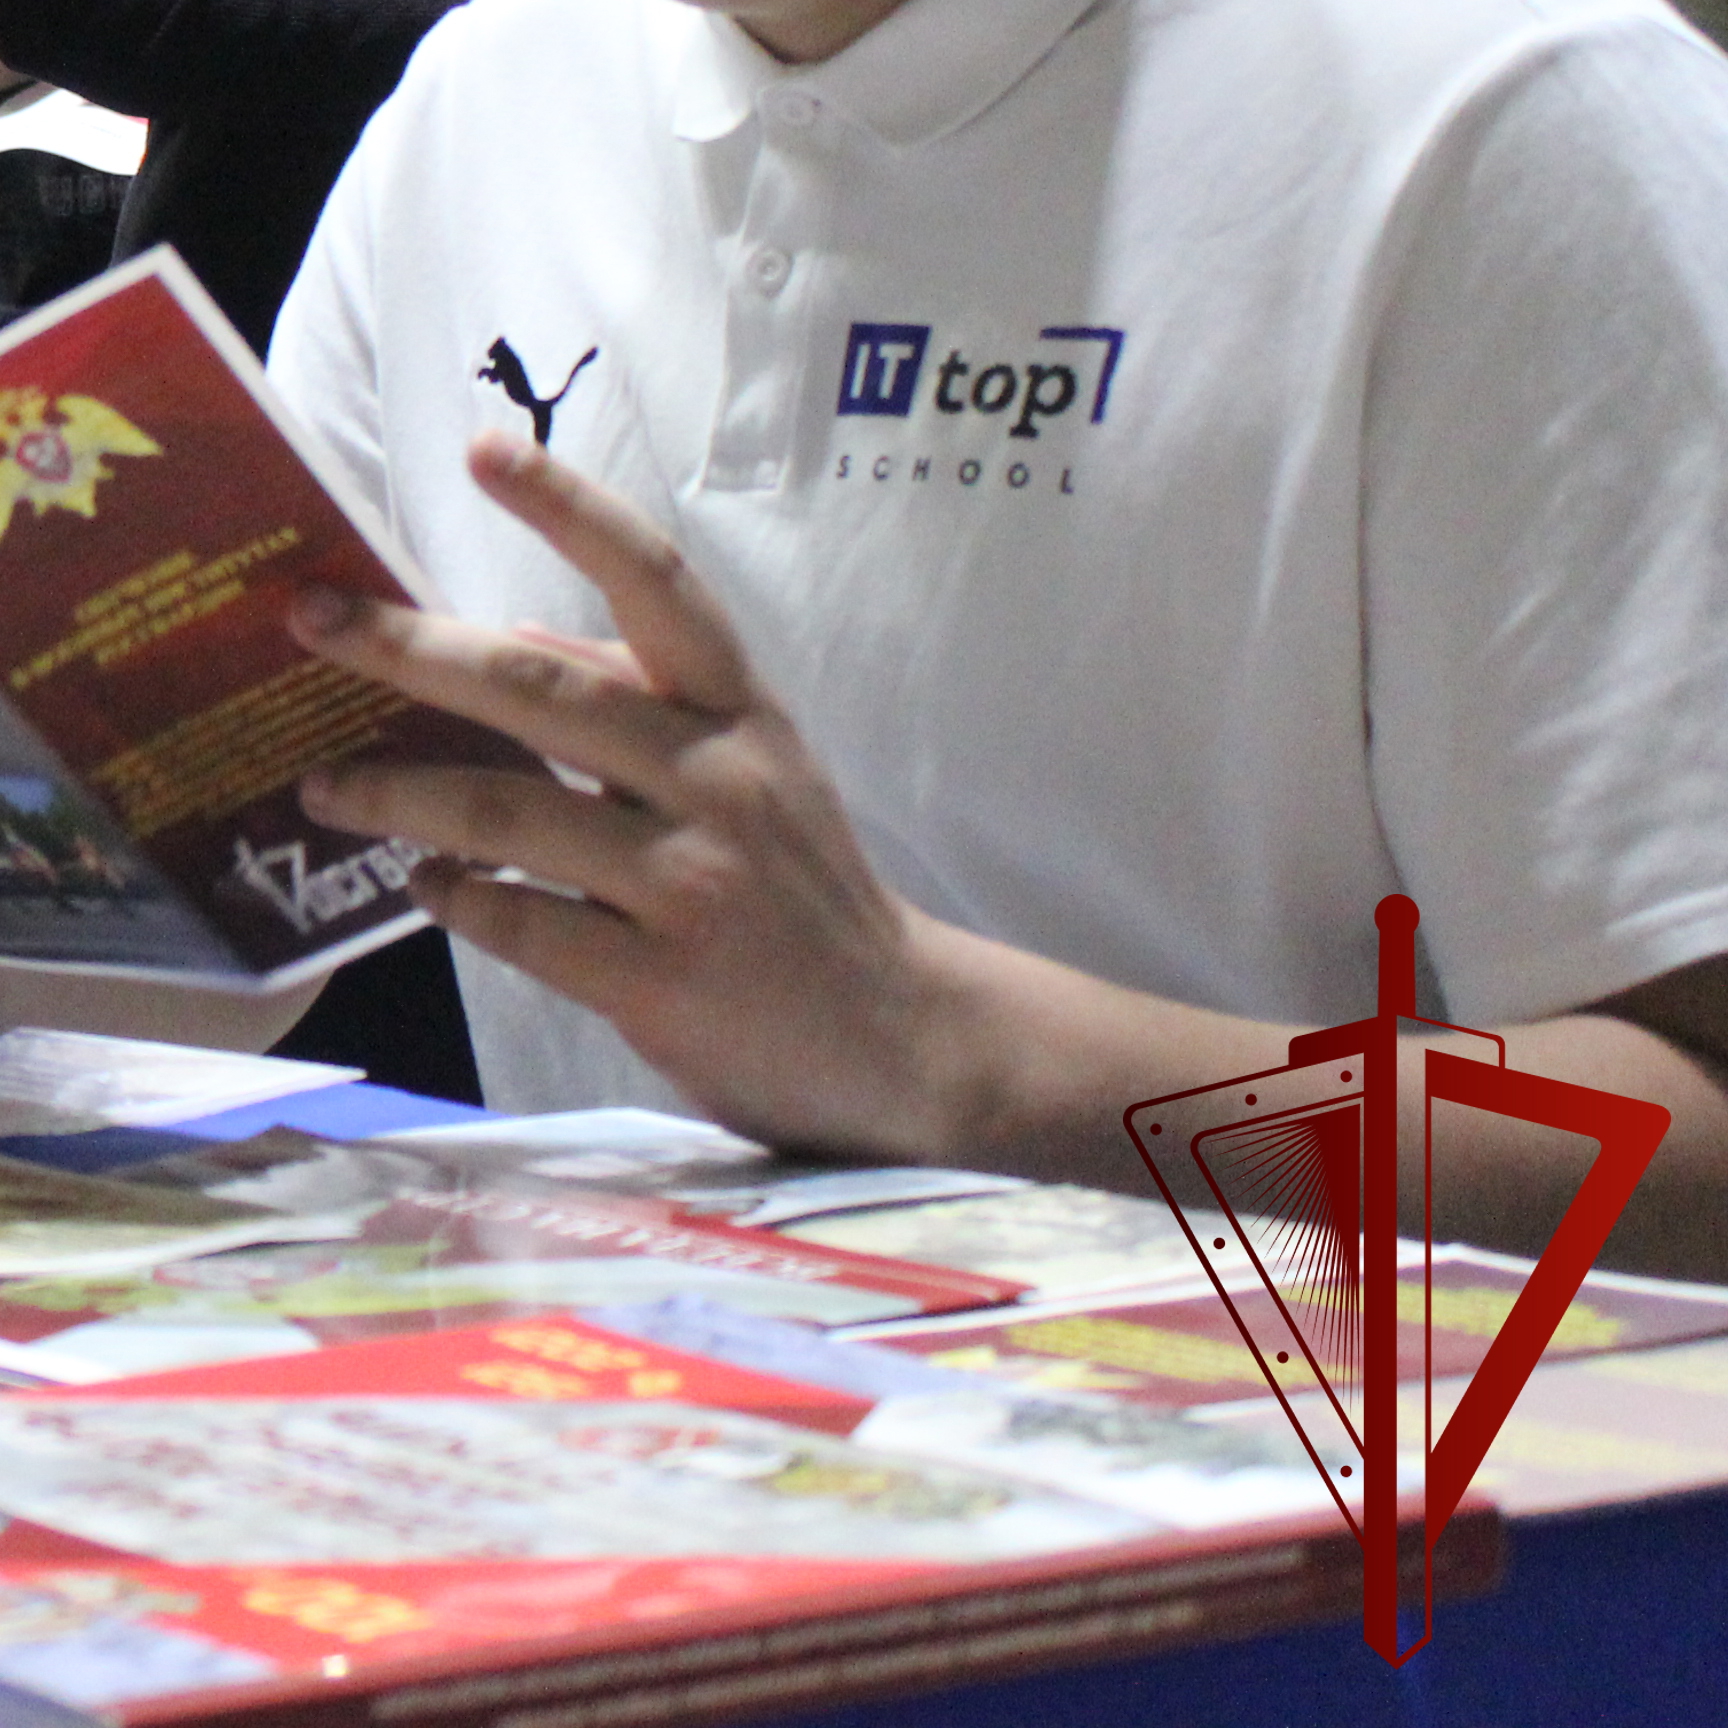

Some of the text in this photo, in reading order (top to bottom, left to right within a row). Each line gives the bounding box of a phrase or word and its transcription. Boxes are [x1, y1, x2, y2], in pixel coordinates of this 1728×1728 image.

[850, 342, 1078, 438] IT top
[835, 454, 1075, 495] SCHOOL
